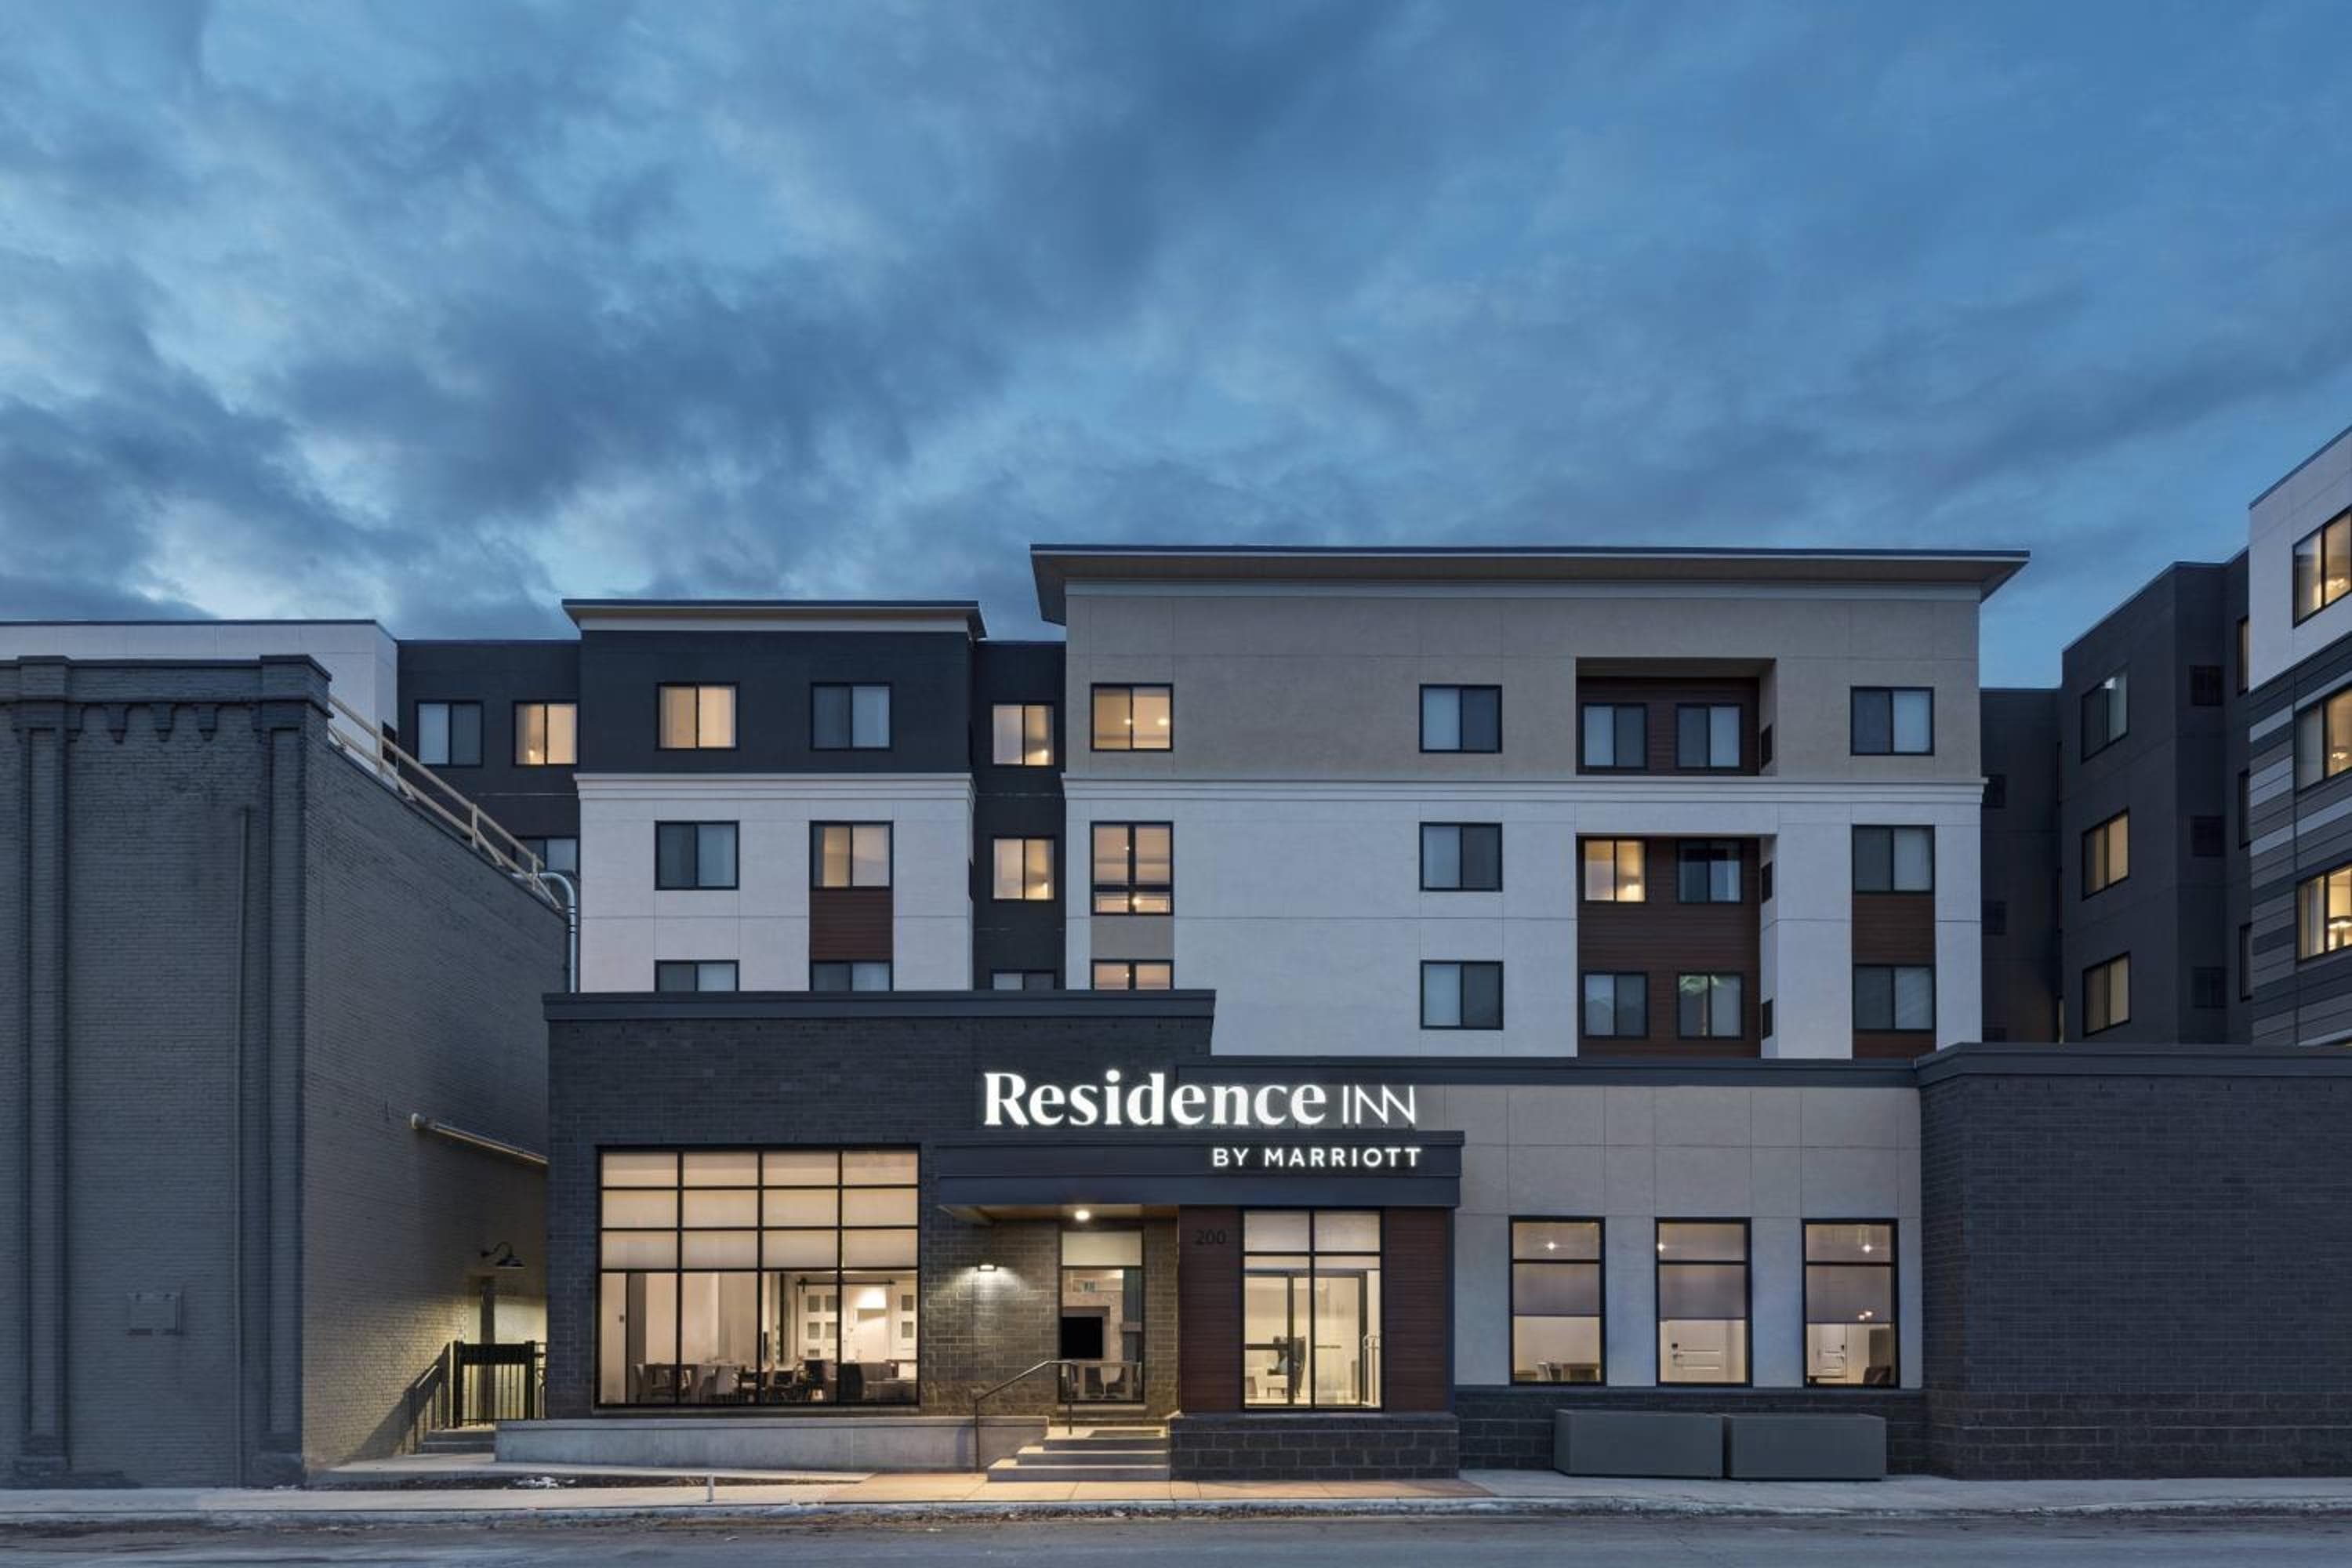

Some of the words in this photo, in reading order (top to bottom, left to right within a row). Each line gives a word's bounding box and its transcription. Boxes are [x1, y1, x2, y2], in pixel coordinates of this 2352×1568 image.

[984, 1070, 1327, 1126] Residence
[1342, 1085, 1416, 1124] INN
[1213, 1148, 1248, 1167] BY
[1265, 1148, 1421, 1167] MARRIOTT
